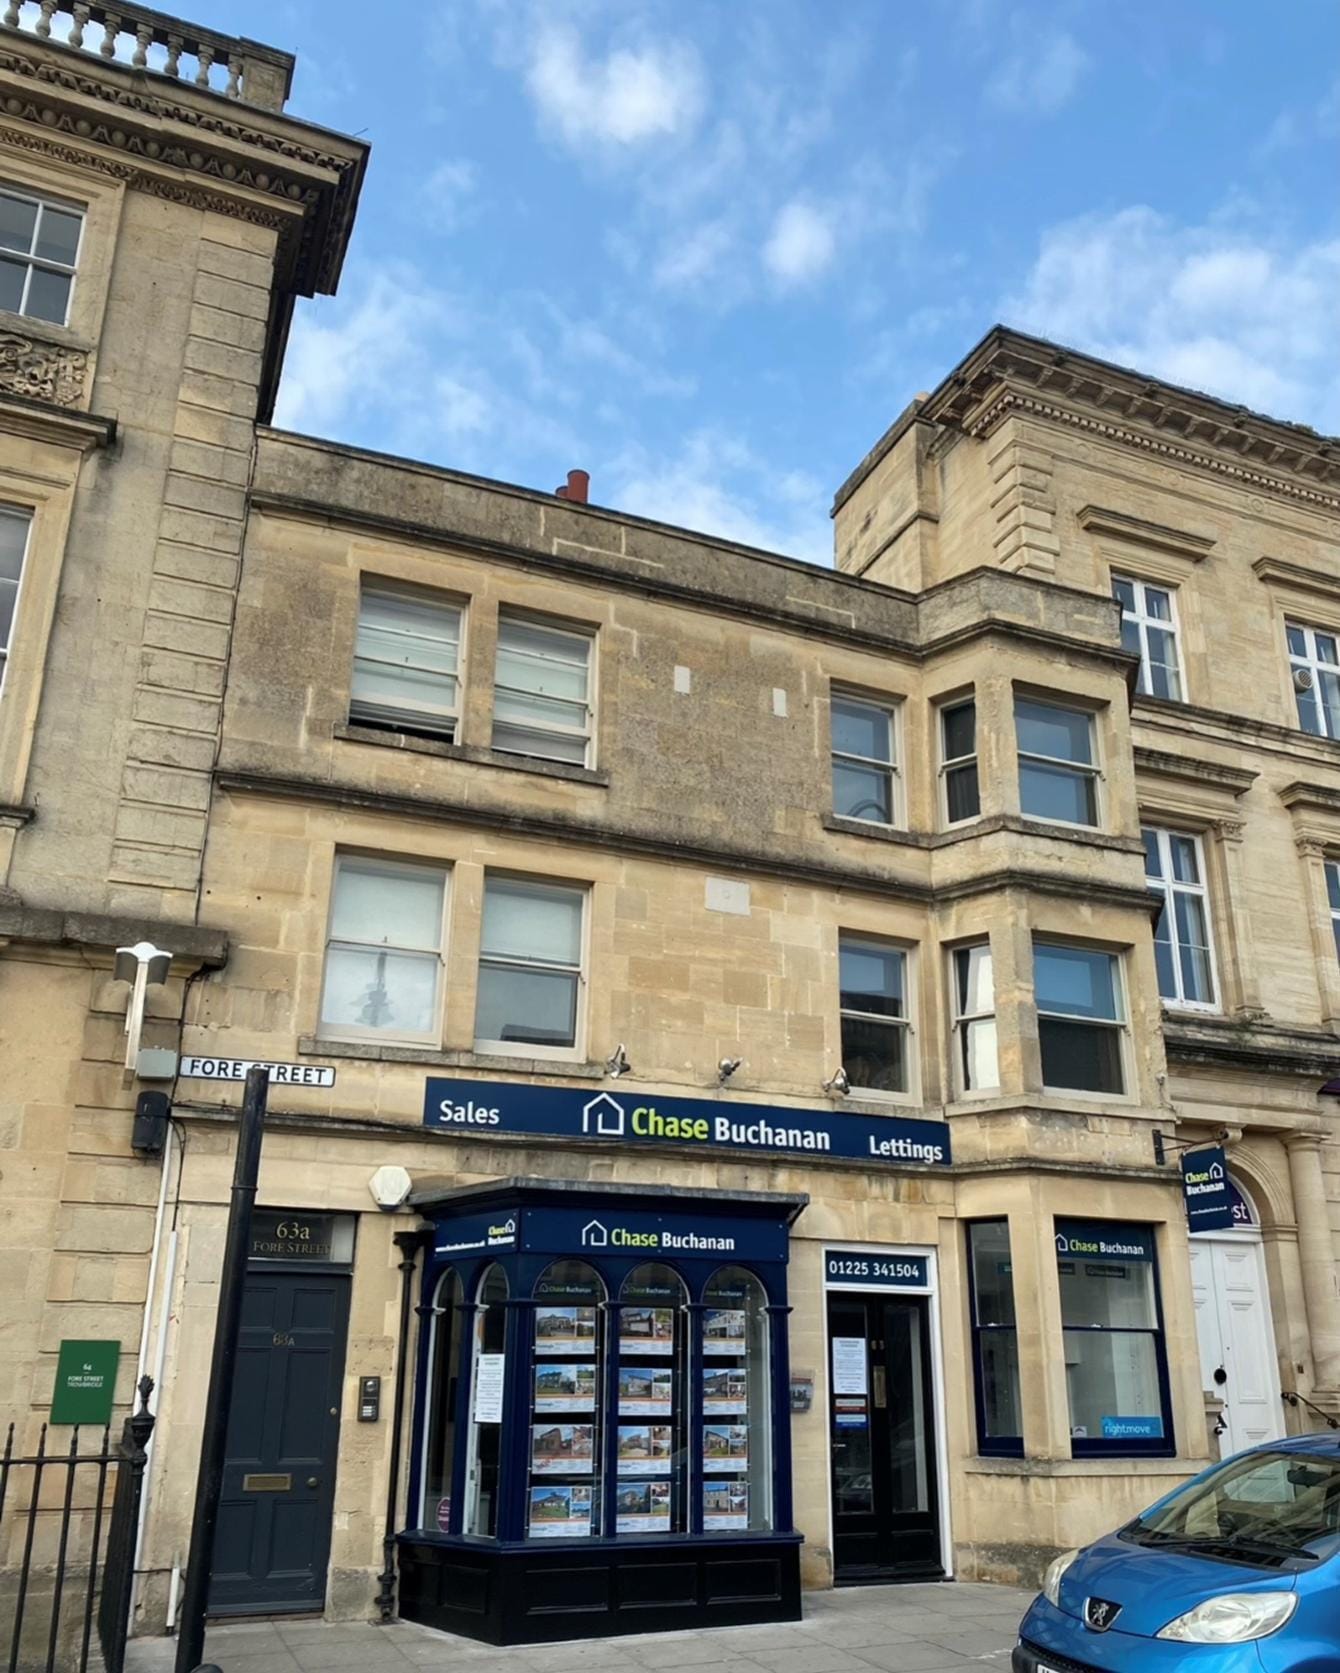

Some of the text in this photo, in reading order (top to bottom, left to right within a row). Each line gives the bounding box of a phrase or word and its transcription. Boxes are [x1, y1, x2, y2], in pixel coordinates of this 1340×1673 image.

[190, 1059, 243, 1077] FORE
[439, 1099, 500, 1125] Sales
[631, 1107, 831, 1151] Chase Buchanan
[869, 1135, 943, 1164] Lettings
[1185, 1171, 1210, 1184] Chase
[1186, 1182, 1225, 1196] Buchanan
[1231, 1201, 1248, 1219] st
[276, 1221, 310, 1240] 63a
[611, 1228, 735, 1250] Chase Buchanan
[1069, 1239, 1144, 1255] Chase Buchanan
[829, 1260, 919, 1278] 01225 341504
[1104, 1424, 1150, 1437] rightmove
